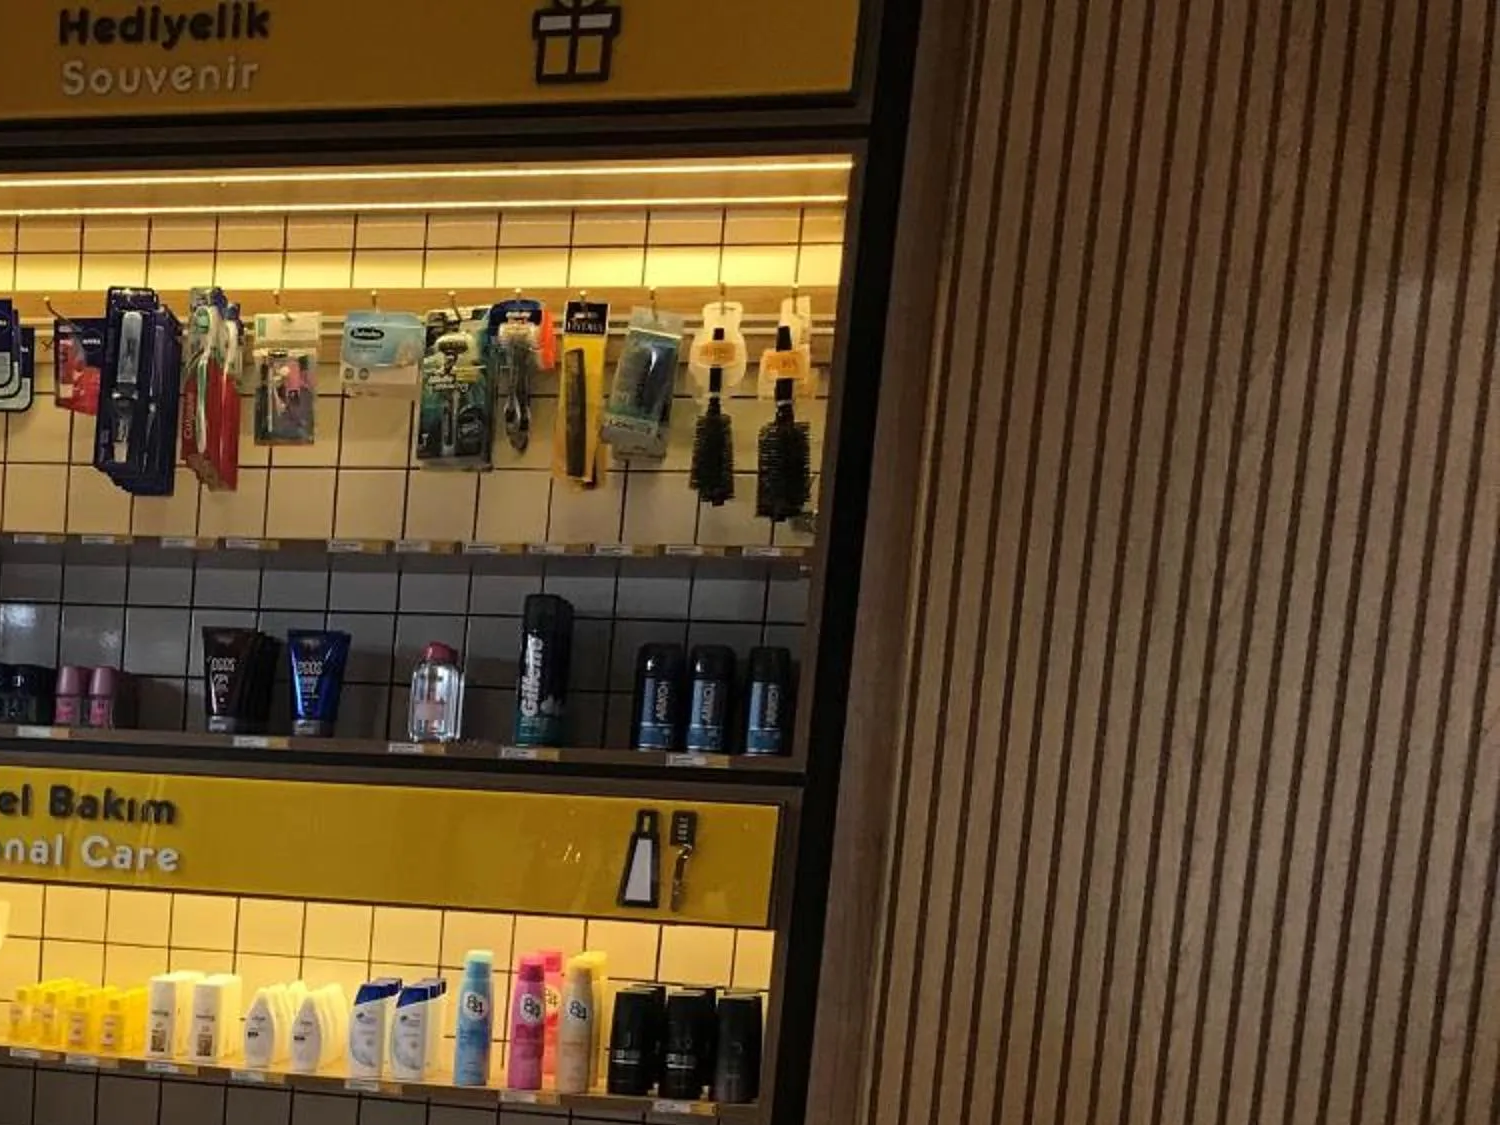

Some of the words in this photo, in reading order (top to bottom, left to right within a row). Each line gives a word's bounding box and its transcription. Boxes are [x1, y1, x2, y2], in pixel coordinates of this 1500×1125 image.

[58, 2, 271, 50] Hediyelik
[61, 56, 259, 96] Souvenir
[48, 784, 177, 825] Bakım
[81, 835, 181, 873] Care
